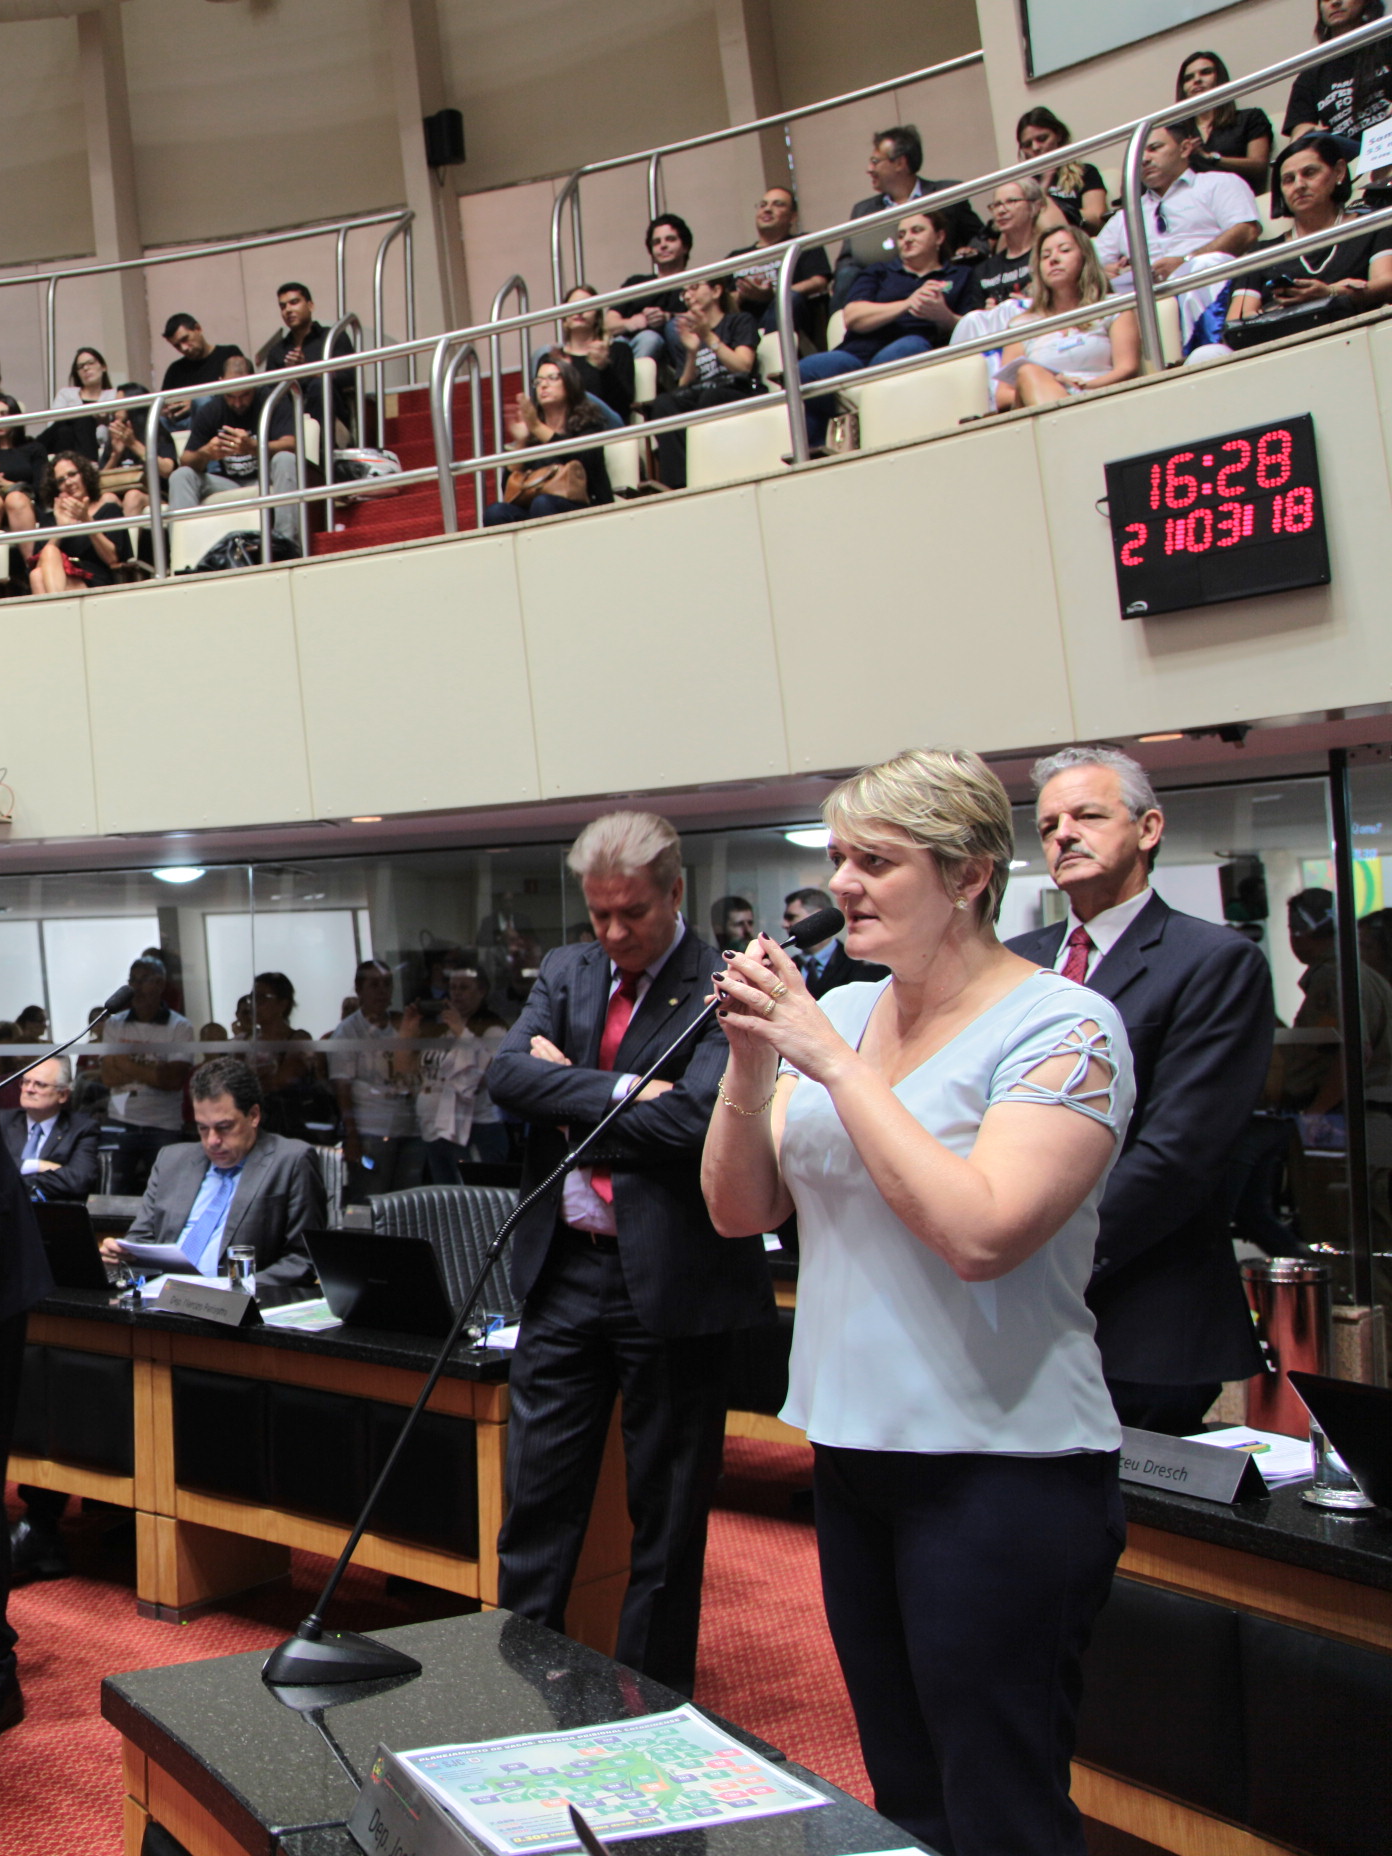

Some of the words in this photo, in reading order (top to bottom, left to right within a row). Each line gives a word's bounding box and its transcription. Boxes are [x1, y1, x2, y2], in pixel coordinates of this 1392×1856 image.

[1150, 429, 1292, 510] 16:28
[1118, 1457, 1140, 1471] ceu
[1143, 1459, 1188, 1481] Dresch
[368, 1807, 390, 1852] Dep.
